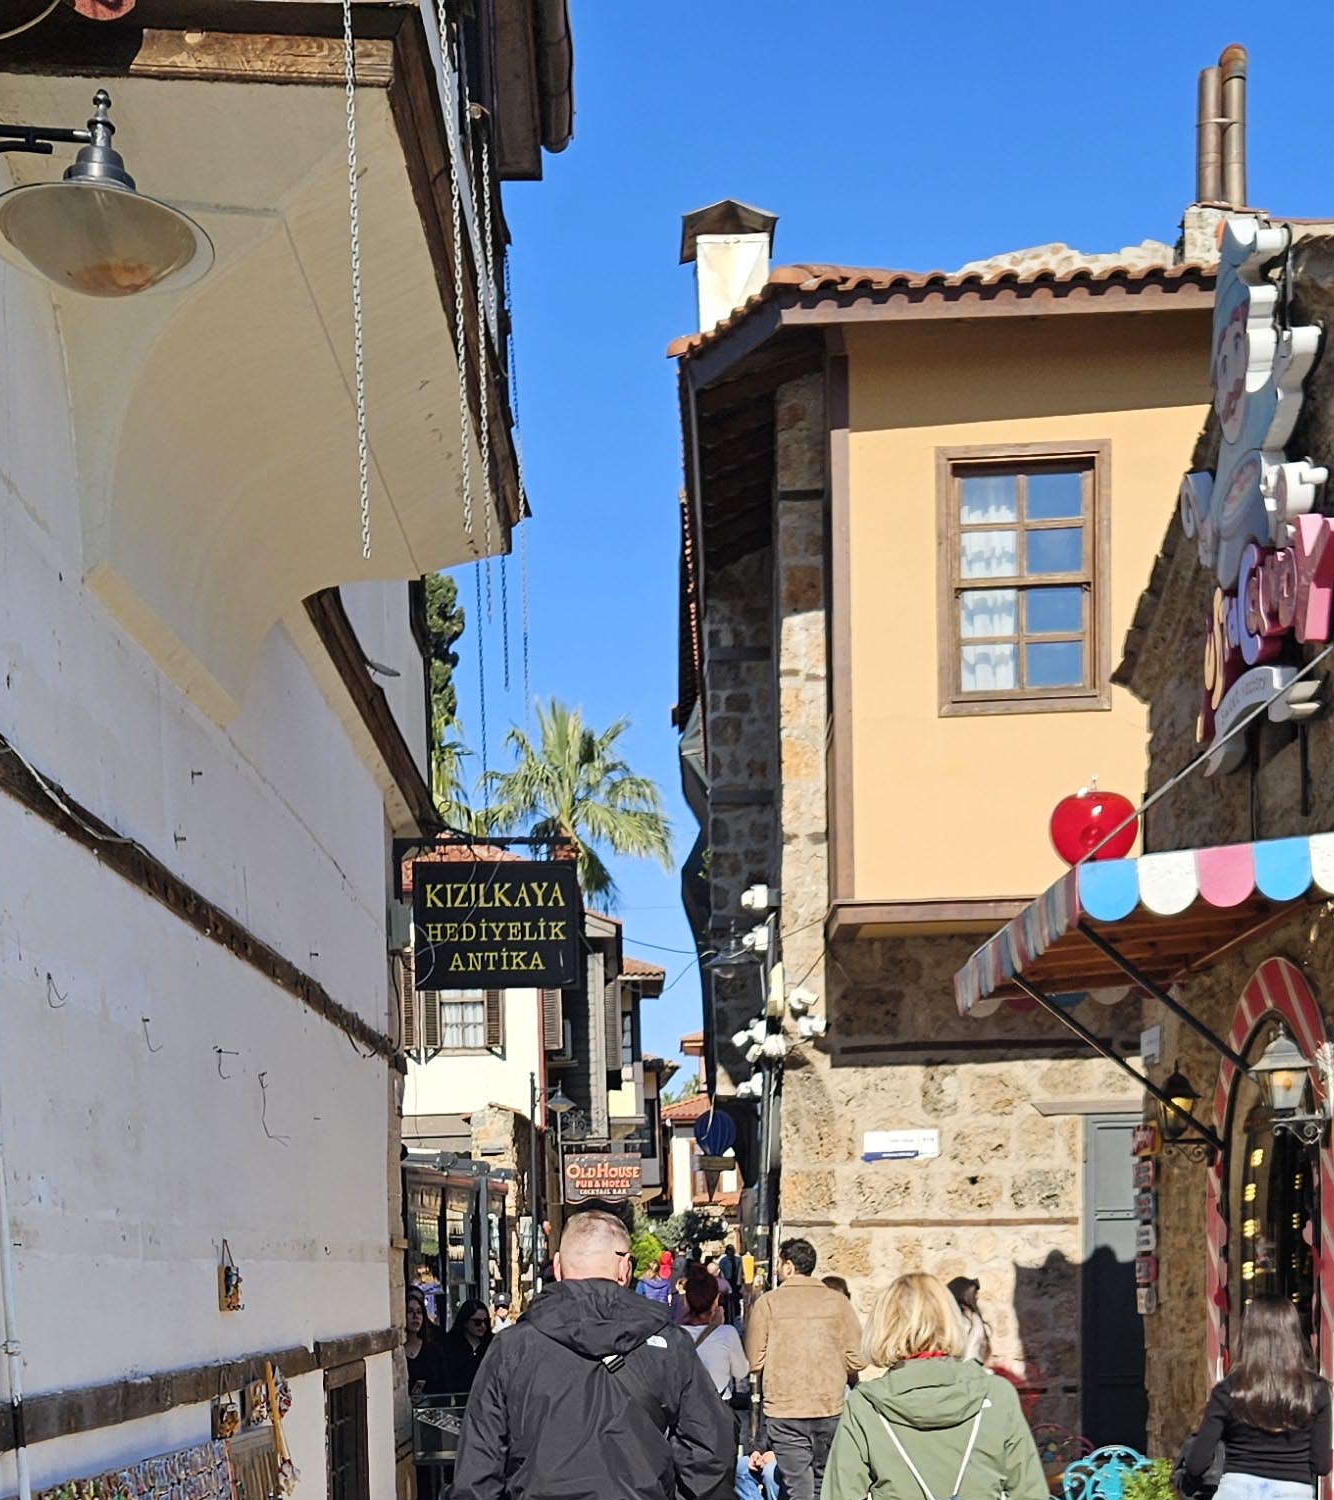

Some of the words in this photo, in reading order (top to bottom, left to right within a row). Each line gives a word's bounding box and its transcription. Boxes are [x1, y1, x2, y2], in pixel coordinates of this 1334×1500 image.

[425, 882, 565, 908] KIZILKAYA
[426, 918, 566, 942] HEDİYELİK
[449, 948, 546, 971] ANTİKA
